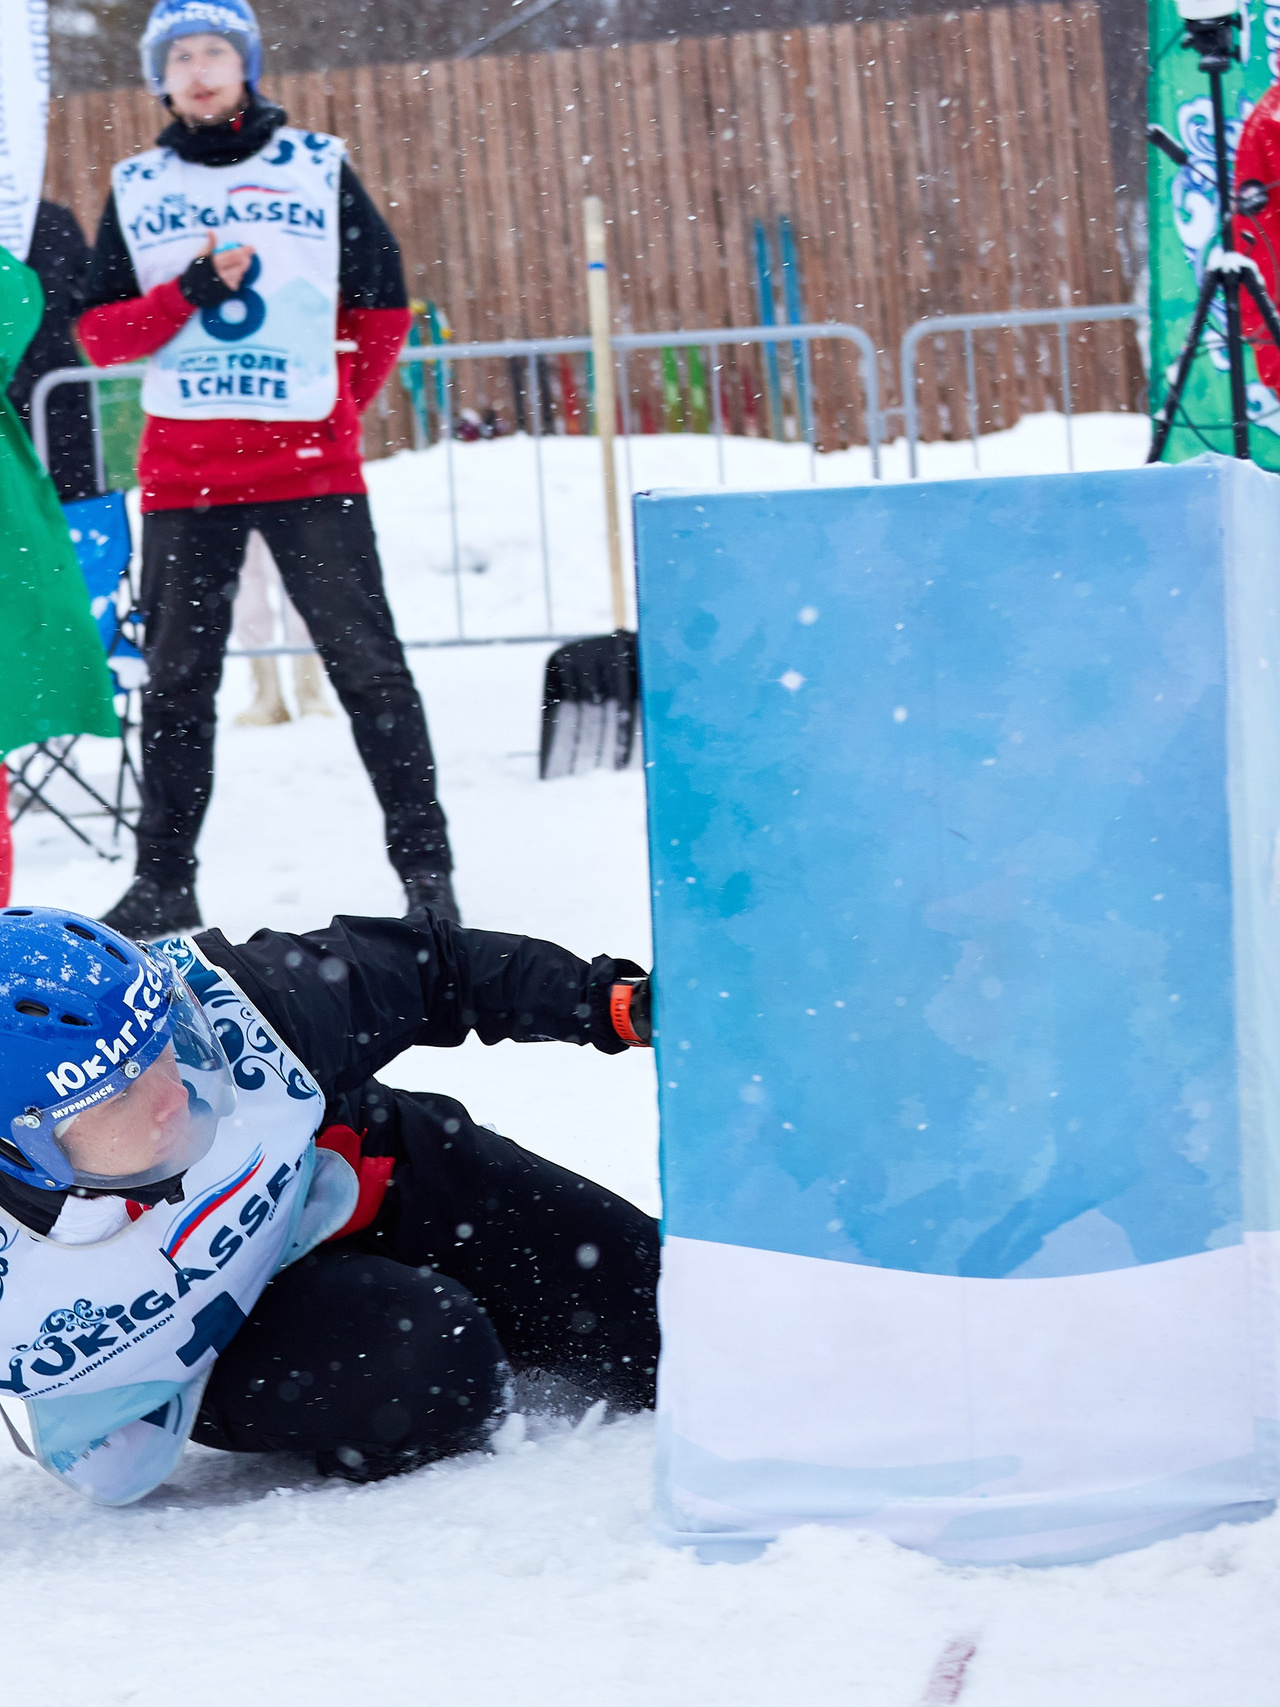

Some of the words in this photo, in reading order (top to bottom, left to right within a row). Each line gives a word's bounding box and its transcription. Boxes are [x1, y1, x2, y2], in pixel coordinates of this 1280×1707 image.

[51, 1083, 115, 1120] МУРМАНСК
[69, 1341, 132, 1382] MURMANSK
[132, 1313, 175, 1344] REGION
